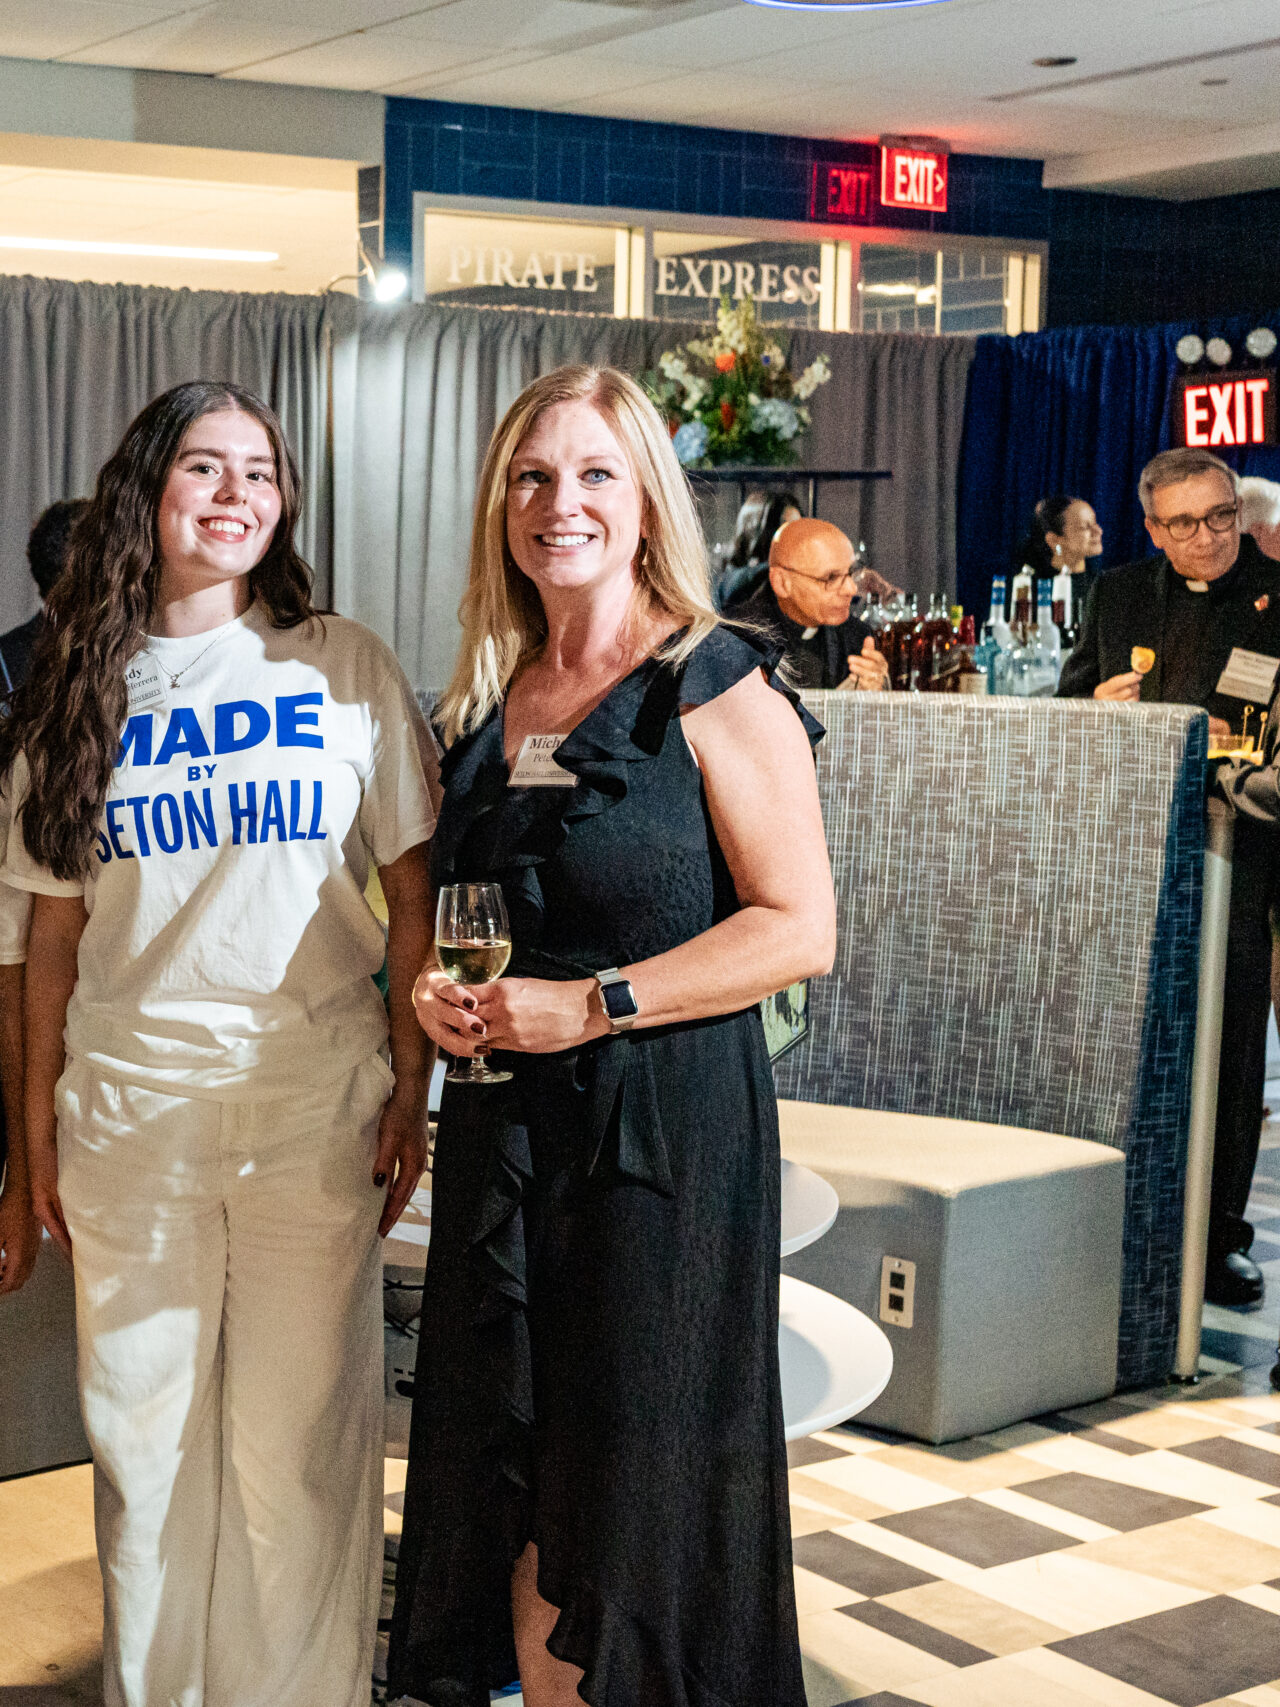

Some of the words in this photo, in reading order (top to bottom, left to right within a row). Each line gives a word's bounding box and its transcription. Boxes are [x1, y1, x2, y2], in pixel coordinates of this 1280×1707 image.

[827, 168, 870, 216] EXIT
[894, 154, 937, 205] EXIT
[446, 243, 599, 293] PIRATE
[655, 256, 821, 305] EXPRESS
[1184, 378, 1269, 448] EXIT
[113, 692, 325, 768] MADE
[187, 764, 217, 782] BY
[228, 779, 328, 845] HALL
